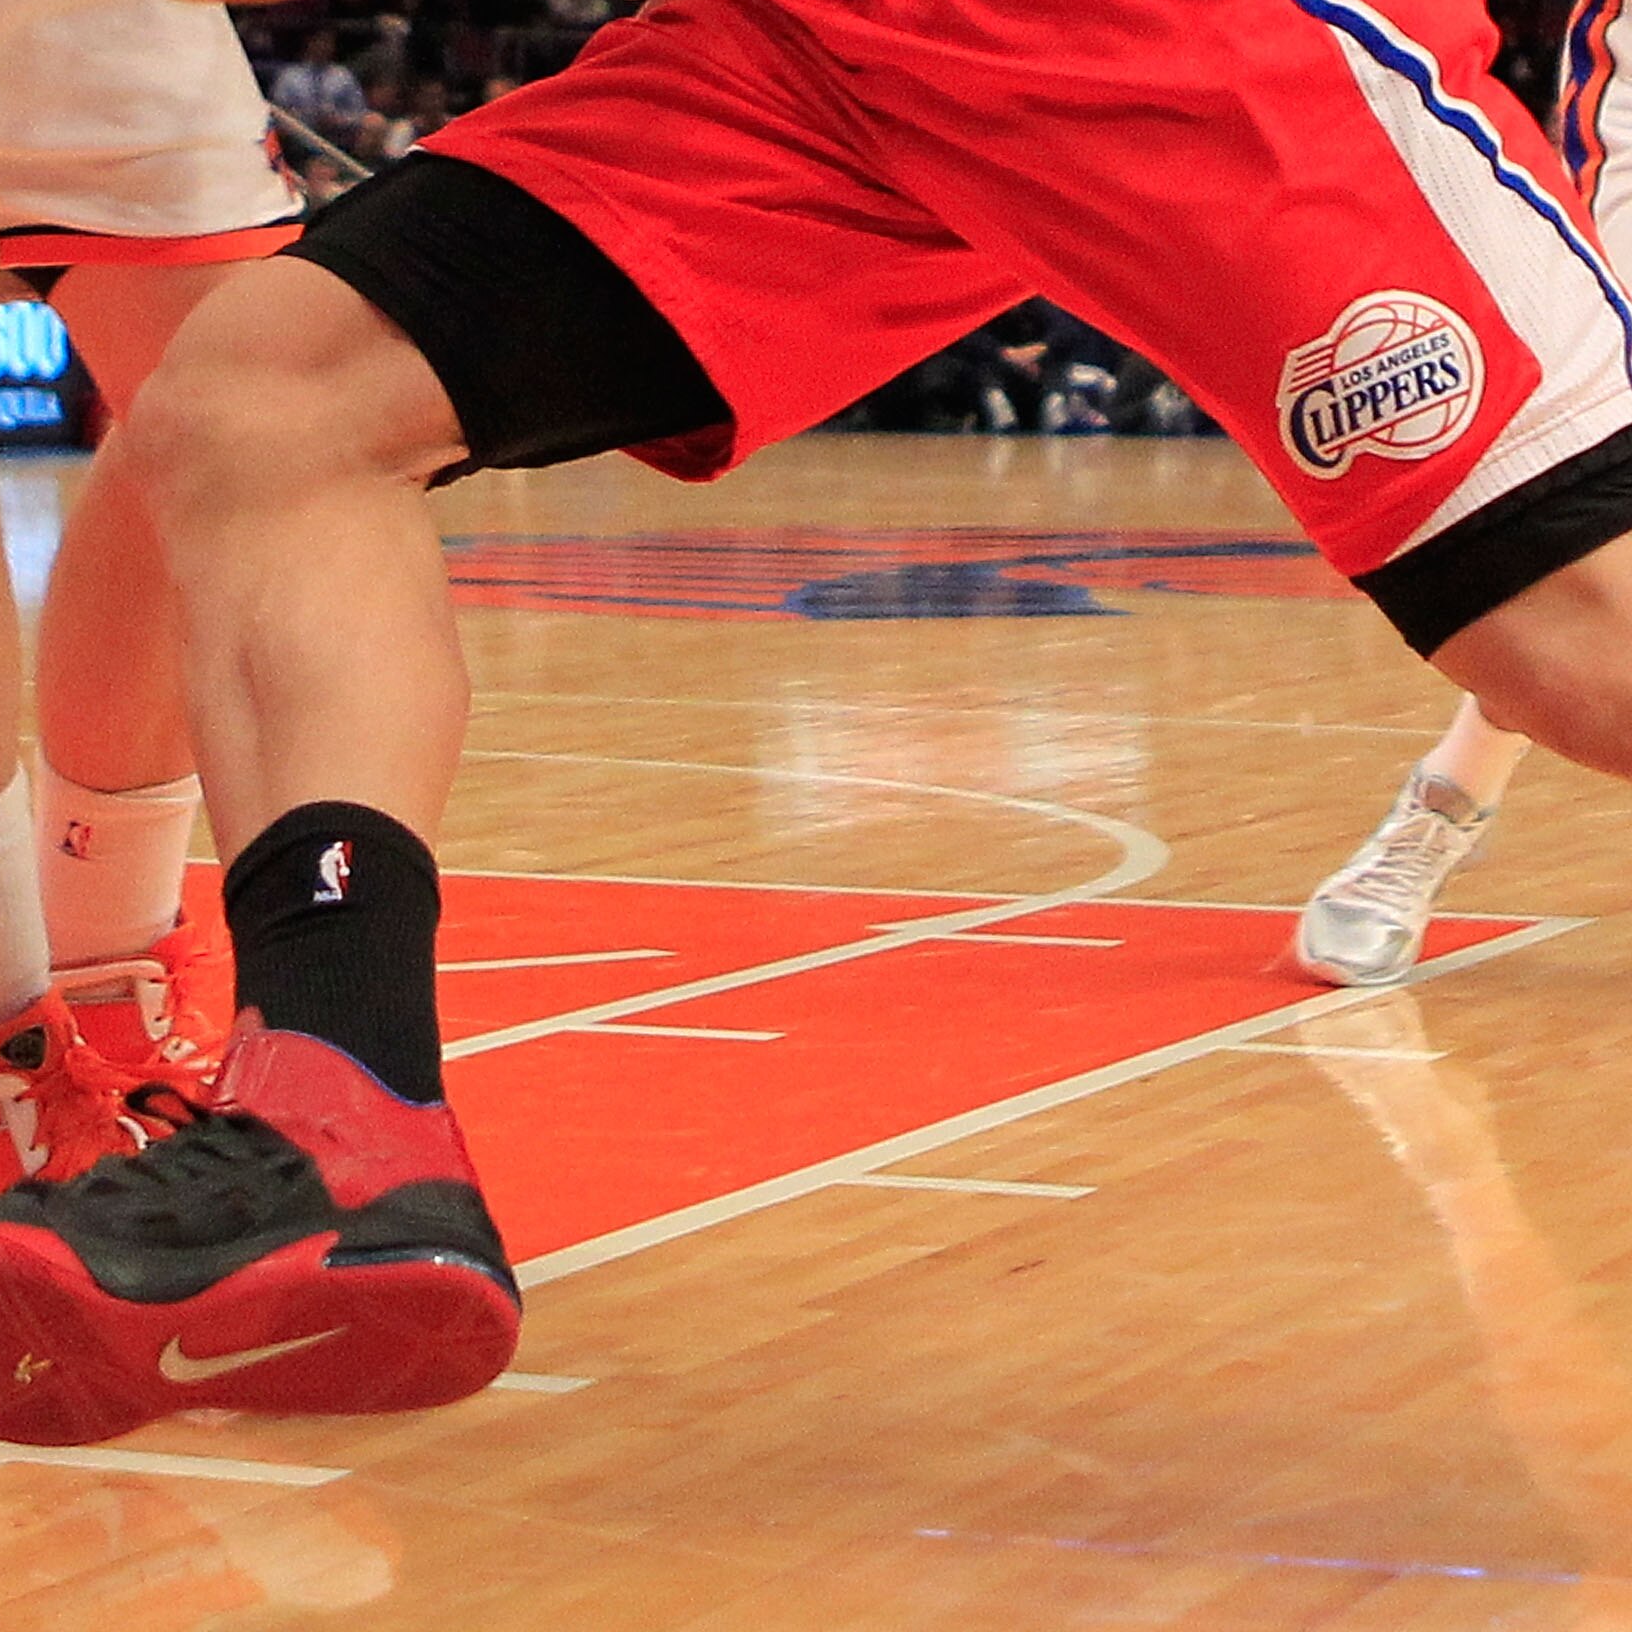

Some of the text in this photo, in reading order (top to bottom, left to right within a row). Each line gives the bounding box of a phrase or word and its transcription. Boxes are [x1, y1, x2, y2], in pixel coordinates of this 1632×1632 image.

[1341, 333, 1451, 391] LOS ANGELES
[1290, 353, 1462, 469] CLIPPERS
